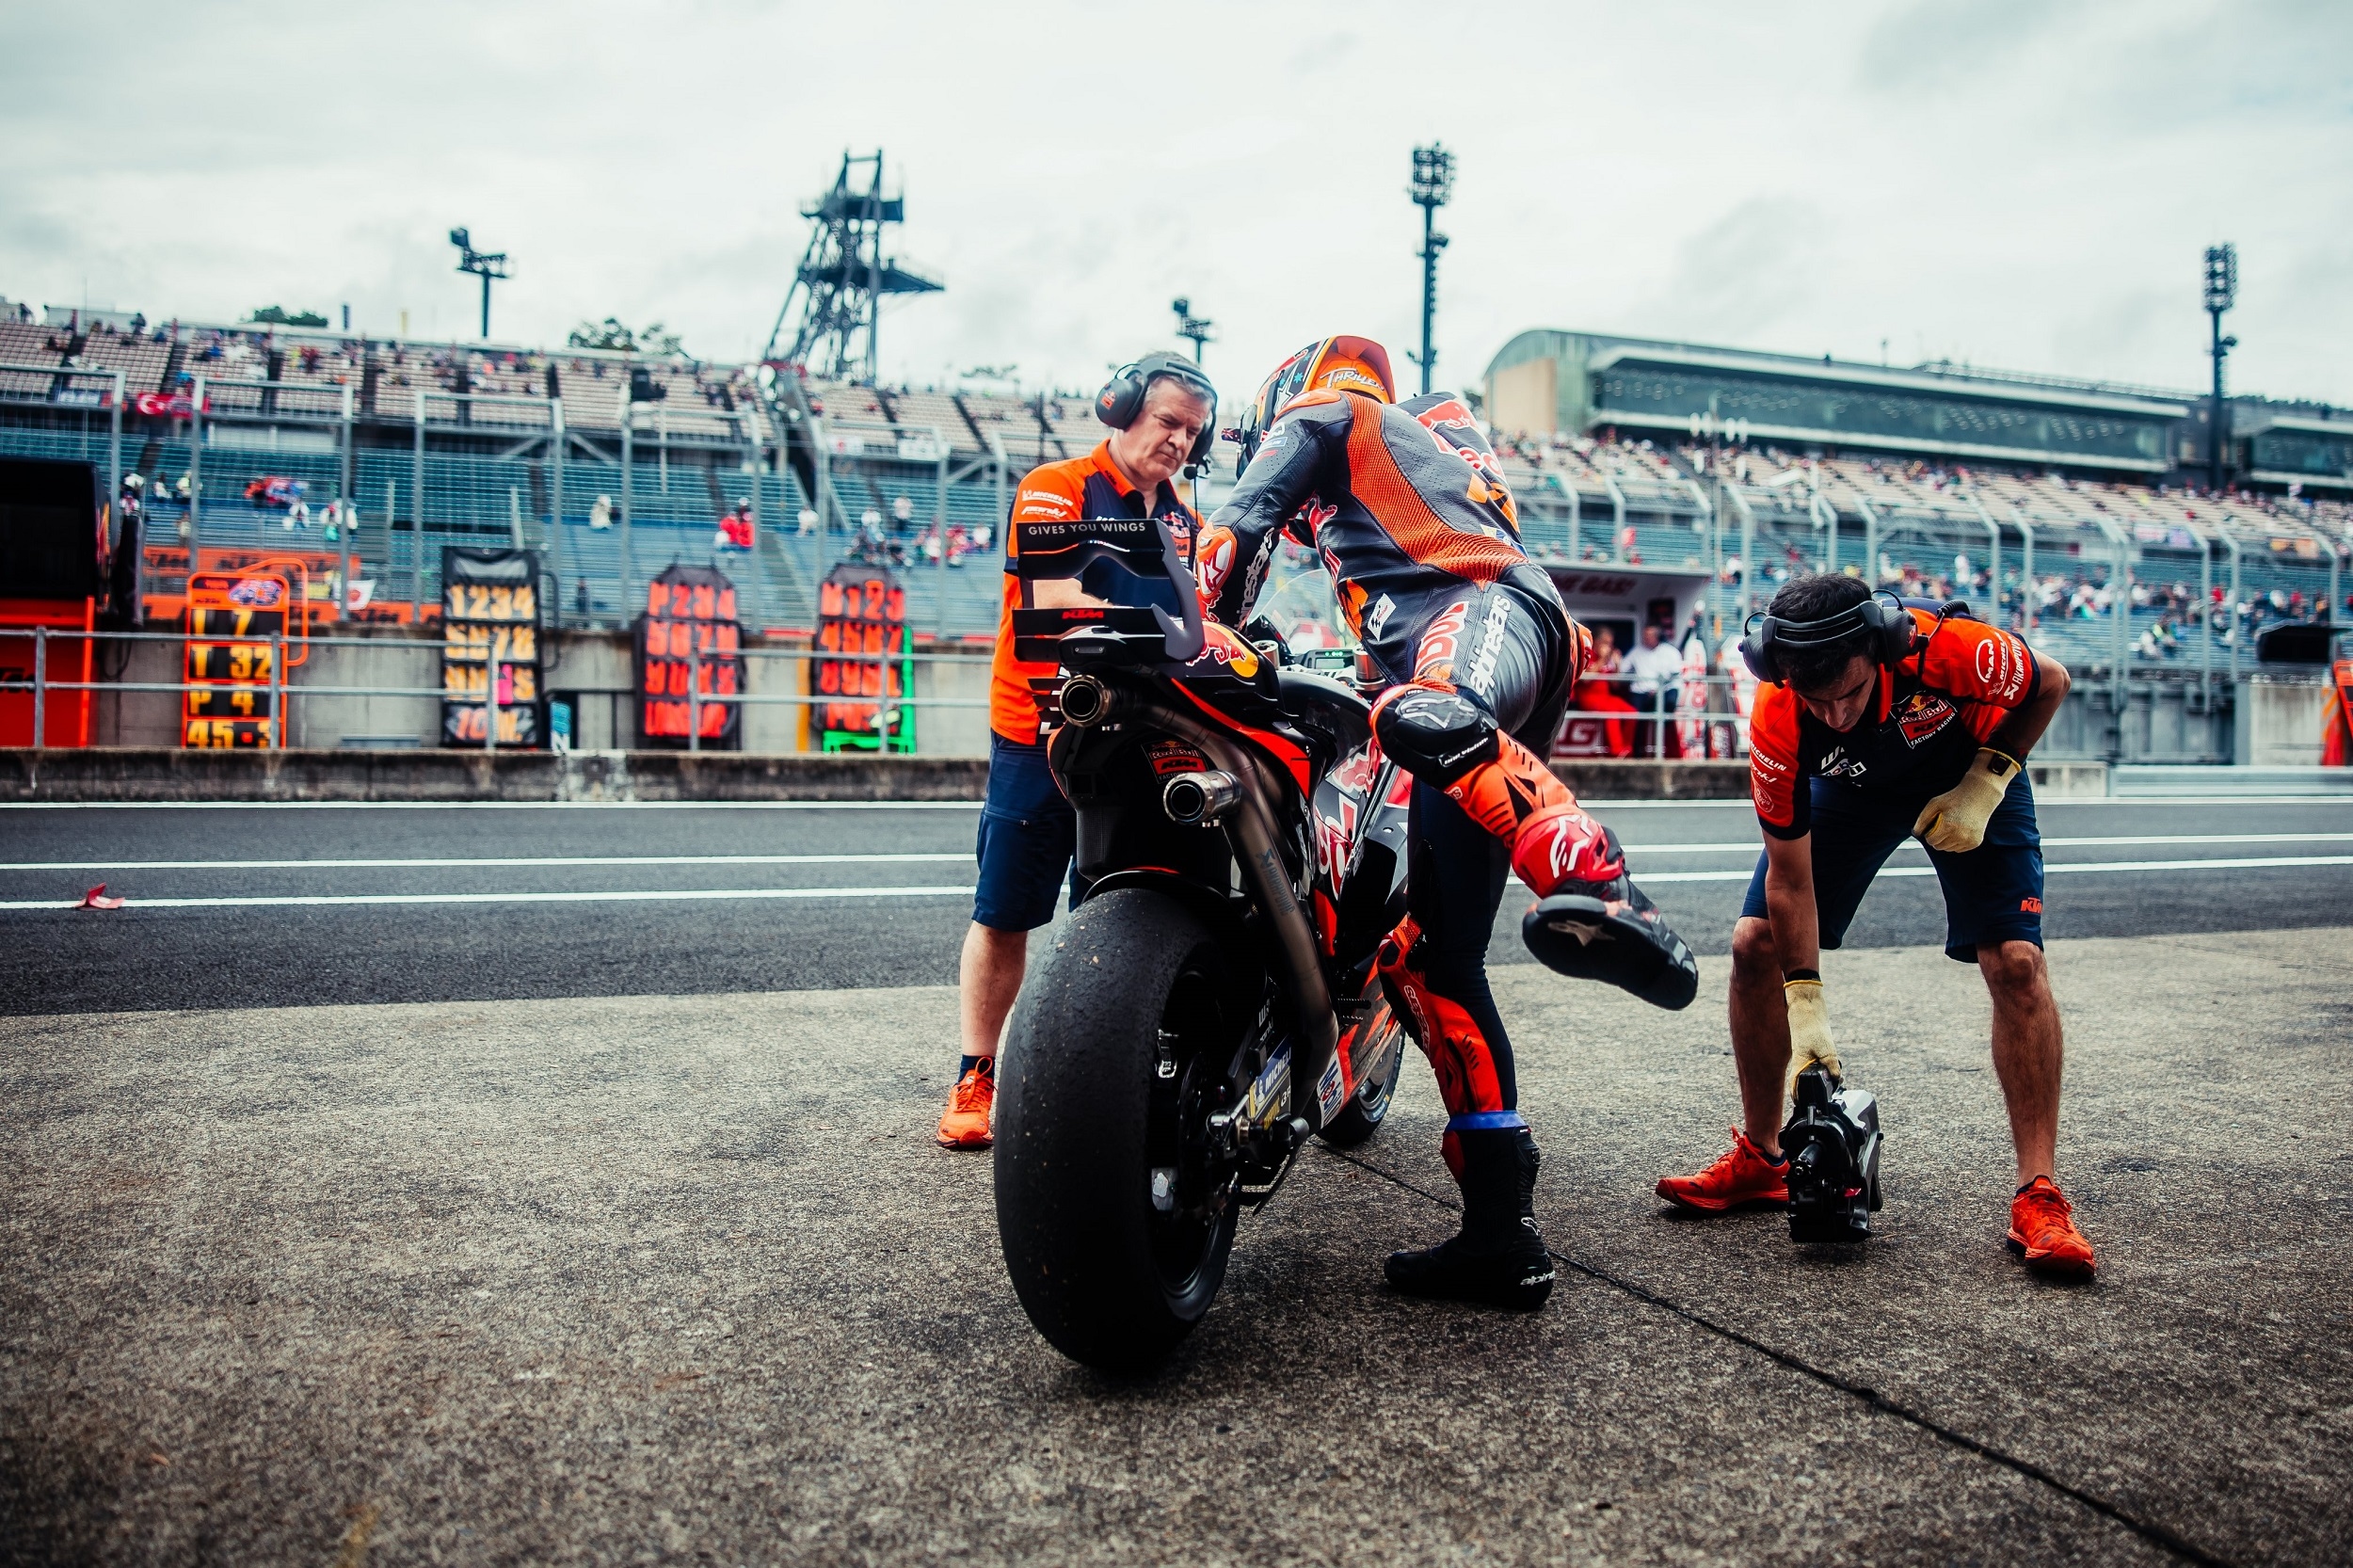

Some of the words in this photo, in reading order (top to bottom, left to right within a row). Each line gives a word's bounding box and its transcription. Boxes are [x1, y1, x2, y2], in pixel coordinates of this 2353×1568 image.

[1034, 490, 1074, 507] MICHELIN
[1028, 524, 1065, 536] GIVES
[1069, 523, 1097, 533] YOU
[1100, 521, 1146, 533] WINGS
[1062, 609, 1104, 619] KTM
[192, 644, 213, 679] T
[229, 645, 272, 680] 32
[1469, 595, 1511, 696] alpinestars
[1985, 642, 1994, 680] MAN
[1923, 699, 1948, 719] Bull
[1911, 731, 1936, 746] FACTORY
[1937, 712, 1956, 732] RACING
[1265, 1047, 1292, 1093] MICHELI
